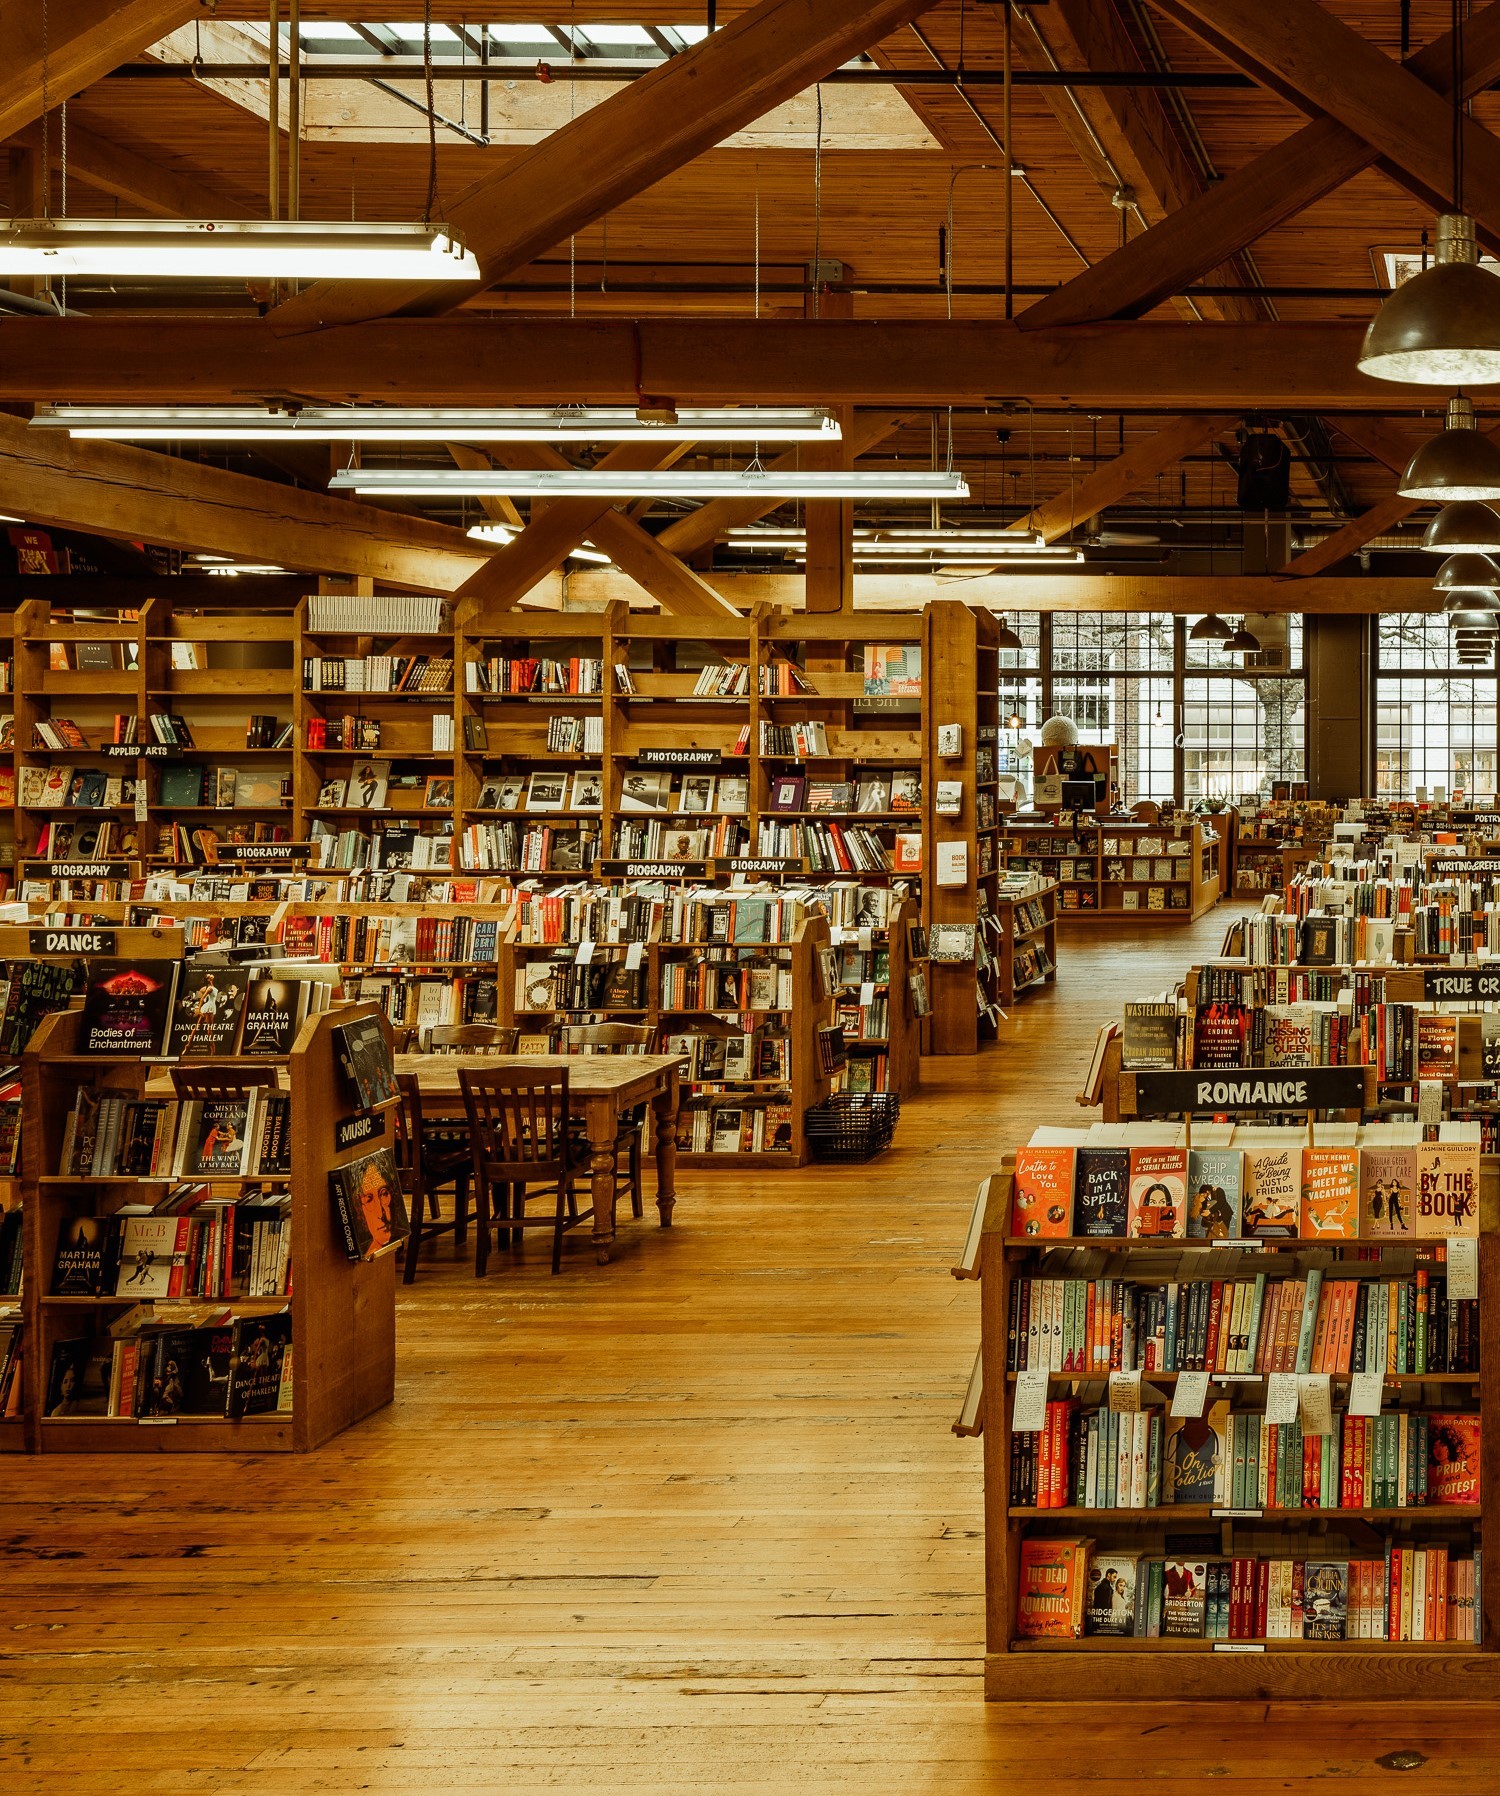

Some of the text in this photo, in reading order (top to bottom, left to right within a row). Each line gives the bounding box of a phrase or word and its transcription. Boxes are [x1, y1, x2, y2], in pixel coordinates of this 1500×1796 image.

[24, 536, 38, 544] WE
[19, 549, 47, 560] THAT
[109, 746, 168, 756] APPLIED ARTS
[647, 751, 714, 762] PHOTOGRAPHY
[236, 846, 292, 858] BIOGRAPHY
[51, 864, 110, 877] BIOGRAPHY
[627, 864, 686, 877] BIOGRAPHY
[731, 860, 786, 871] BIOGRAPHY
[258, 885, 274, 893] SHOE
[476, 923, 496, 933] CARL
[46, 933, 101, 952] DANCE
[474, 938, 494, 947] BERN
[473, 950, 493, 961] STEIN
[1432, 978, 1473, 994] TRUE
[248, 1012, 289, 1020] MARTHA
[1125, 1005, 1174, 1017] WASTELANDS
[174, 1023, 234, 1031] DANCE THEATRE
[246, 1022, 289, 1030] GRAHAM
[1271, 1019, 1292, 1027] THE
[91, 1027, 135, 1038] Bodies of
[1269, 1027, 1311, 1036] MISSING
[89, 1039, 152, 1049] Enchantment
[1266, 1037, 1308, 1045] CRYPTO
[1274, 1045, 1311, 1055] QUEEN
[1197, 1080, 1309, 1105] ROMANCE
[342, 1118, 371, 1143] MUSIC
[1202, 1162, 1227, 1174] SHIP
[1307, 1163, 1354, 1178] PEOPLE WE
[1088, 1171, 1118, 1184] BACK
[1190, 1174, 1237, 1186] WRECKED
[1259, 1178, 1281, 1187] JUST
[1421, 1173, 1472, 1192] BY THE
[1040, 1180, 1057, 1188] You
[1256, 1186, 1294, 1196] FRIENDS
[1308, 1186, 1351, 1200] VACATION
[1083, 1193, 1121, 1206] SPELL
[1421, 1193, 1472, 1217] BOOK
[1436, 1460, 1468, 1477] PRIDE
[1431, 1479, 1477, 1497] PROTEST
[1027, 1568, 1067, 1584] THE DEAD
[1020, 1596, 1070, 1614] ROMANTICS
[1165, 1600, 1204, 1608] BRIDGERTON
